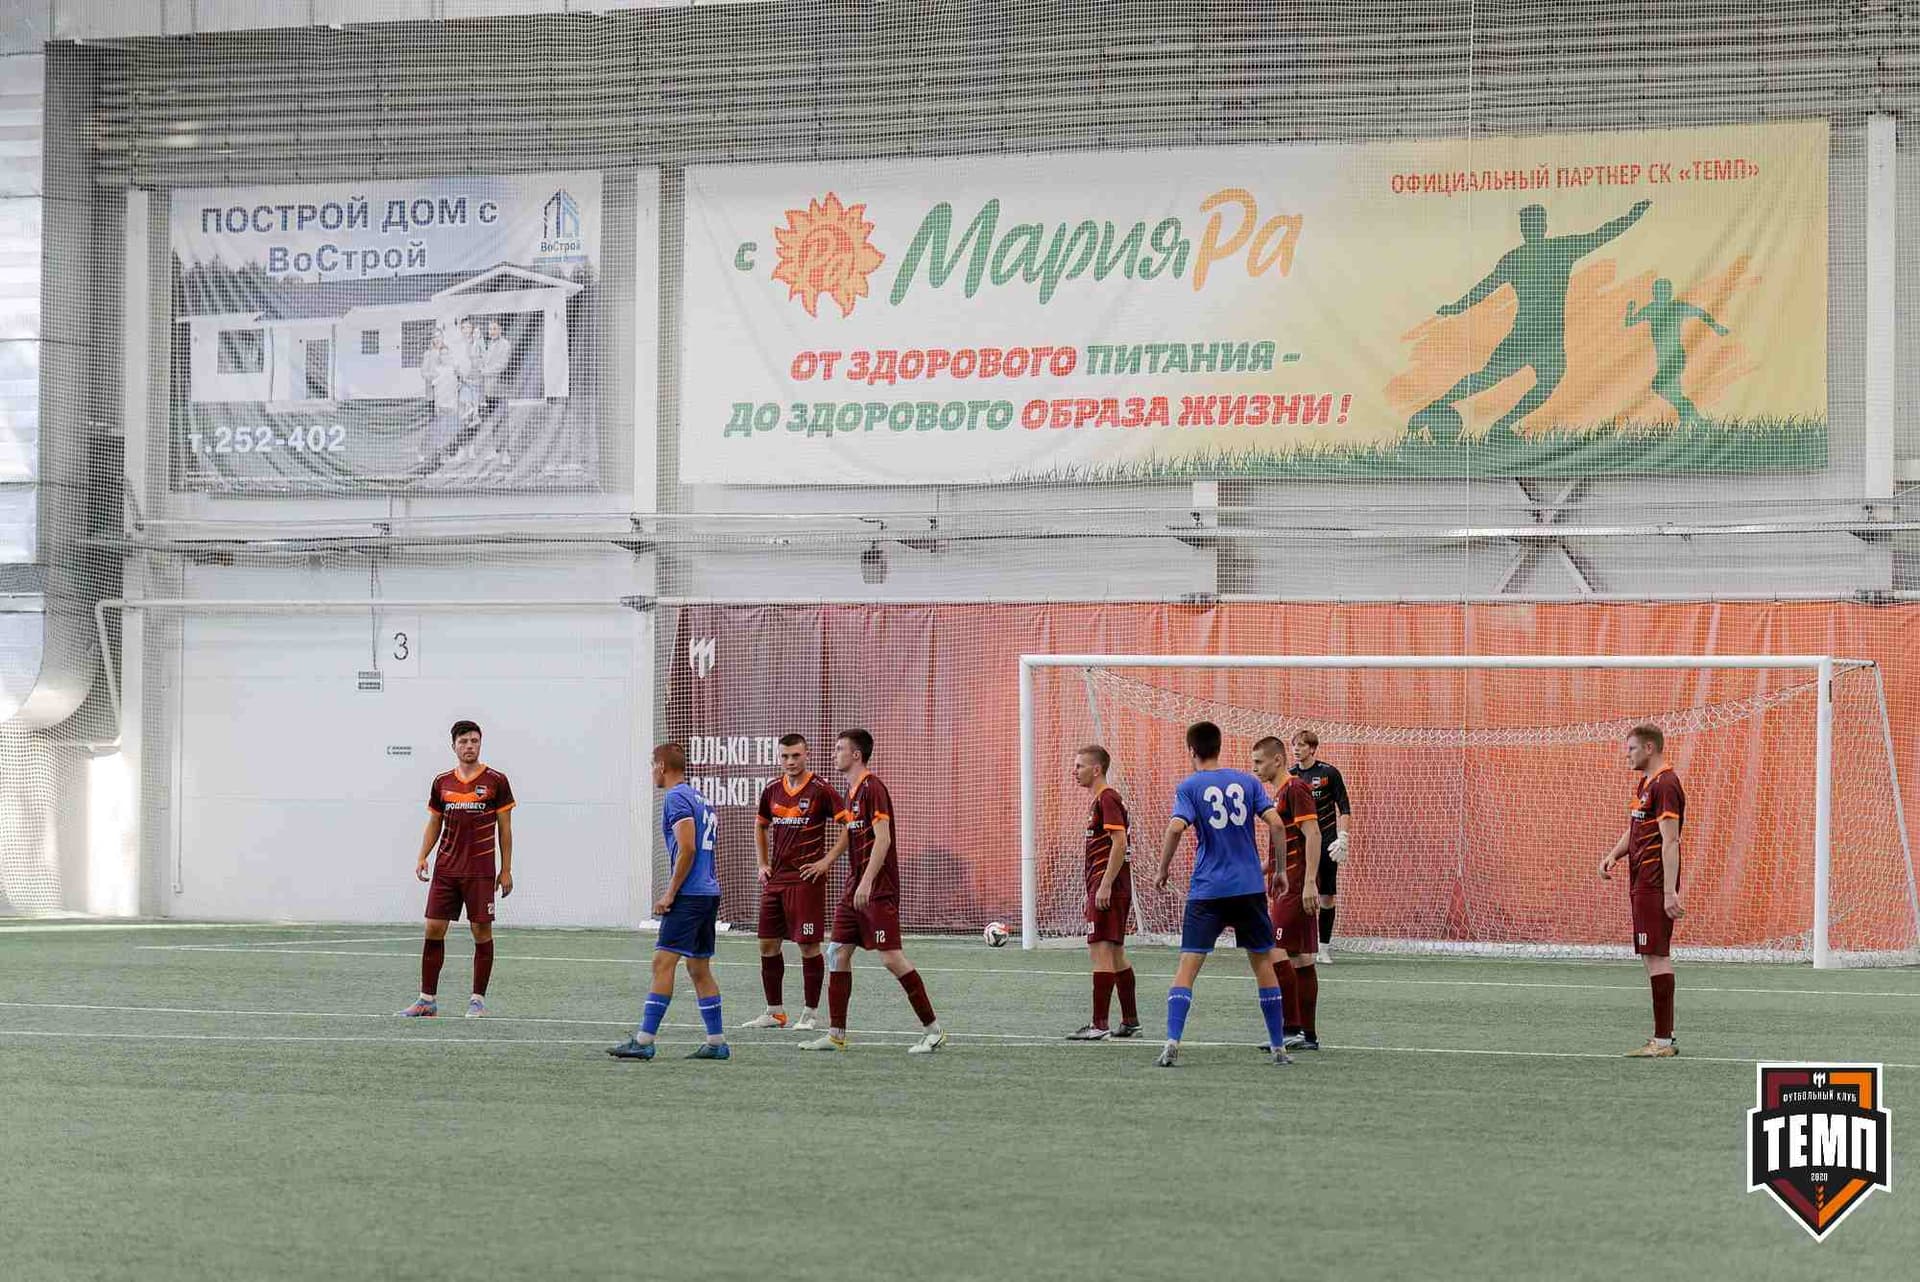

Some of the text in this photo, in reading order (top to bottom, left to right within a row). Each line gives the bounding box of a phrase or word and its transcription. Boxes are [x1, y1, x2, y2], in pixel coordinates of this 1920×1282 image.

[1391, 162, 1549, 197] ОФИЦИАЛЬНЫЙ
[1557, 164, 1641, 188] ПАРТНЕР
[1649, 163, 1671, 184] СК
[201, 195, 368, 233] ПОСТРОЙ
[381, 197, 467, 233] ДОМ
[268, 240, 426, 276] ВоСтрой
[790, 350, 842, 381] ОТ
[847, 345, 1077, 385] ЗДОРОВОГО
[1086, 340, 1275, 376] ПИТАНИЯ
[724, 402, 781, 437] ДО
[786, 400, 1013, 437] ЗДОРОВОГО
[1021, 396, 1169, 430] ОБРАЗА
[394, 632, 409, 661] 3
[691, 735, 750, 766] ОЛЬКО
[1203, 783, 1248, 829] 33
[1276, 927, 1283, 940] 9
[1638, 932, 1648, 945] 10
